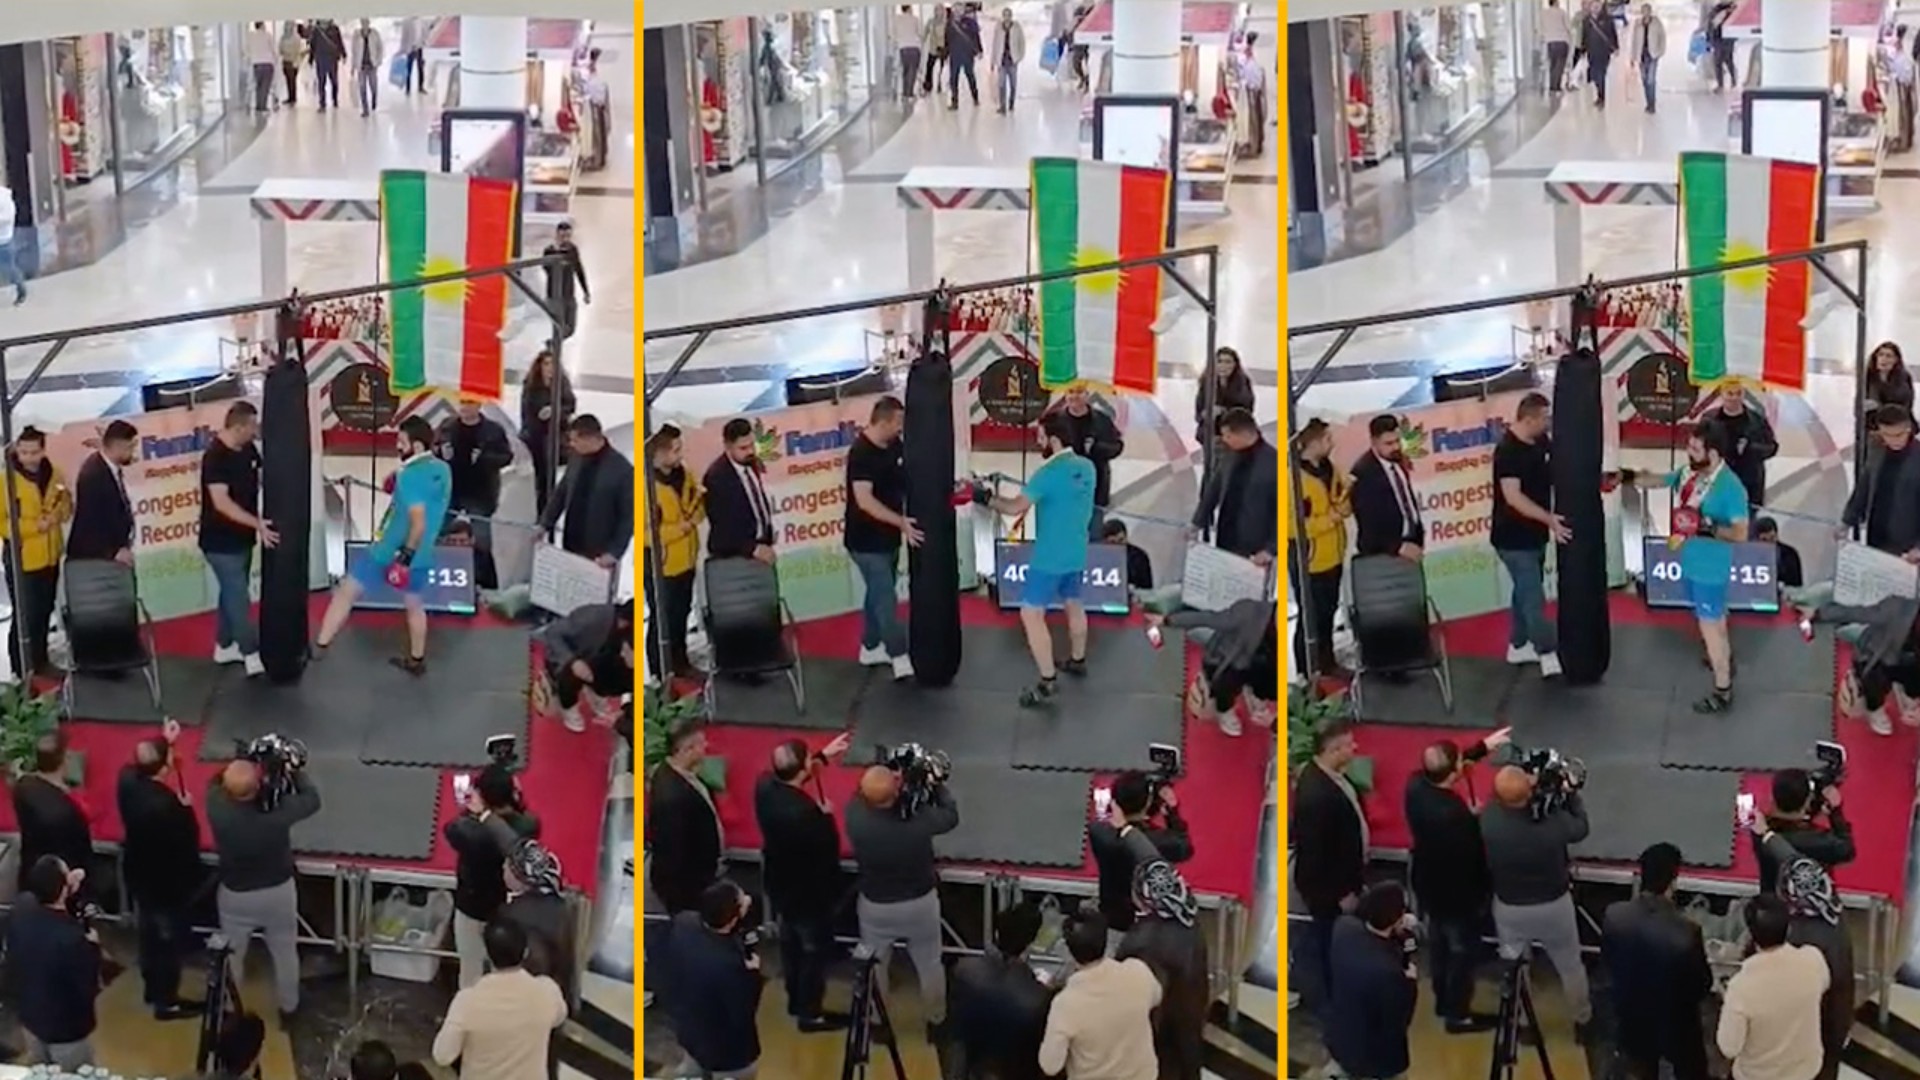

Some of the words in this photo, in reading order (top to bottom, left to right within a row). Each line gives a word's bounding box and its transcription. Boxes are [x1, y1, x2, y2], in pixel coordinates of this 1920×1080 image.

[133, 488, 200, 516] ongest
[771, 484, 846, 514] Longest
[1652, 562, 1682, 581] 40
